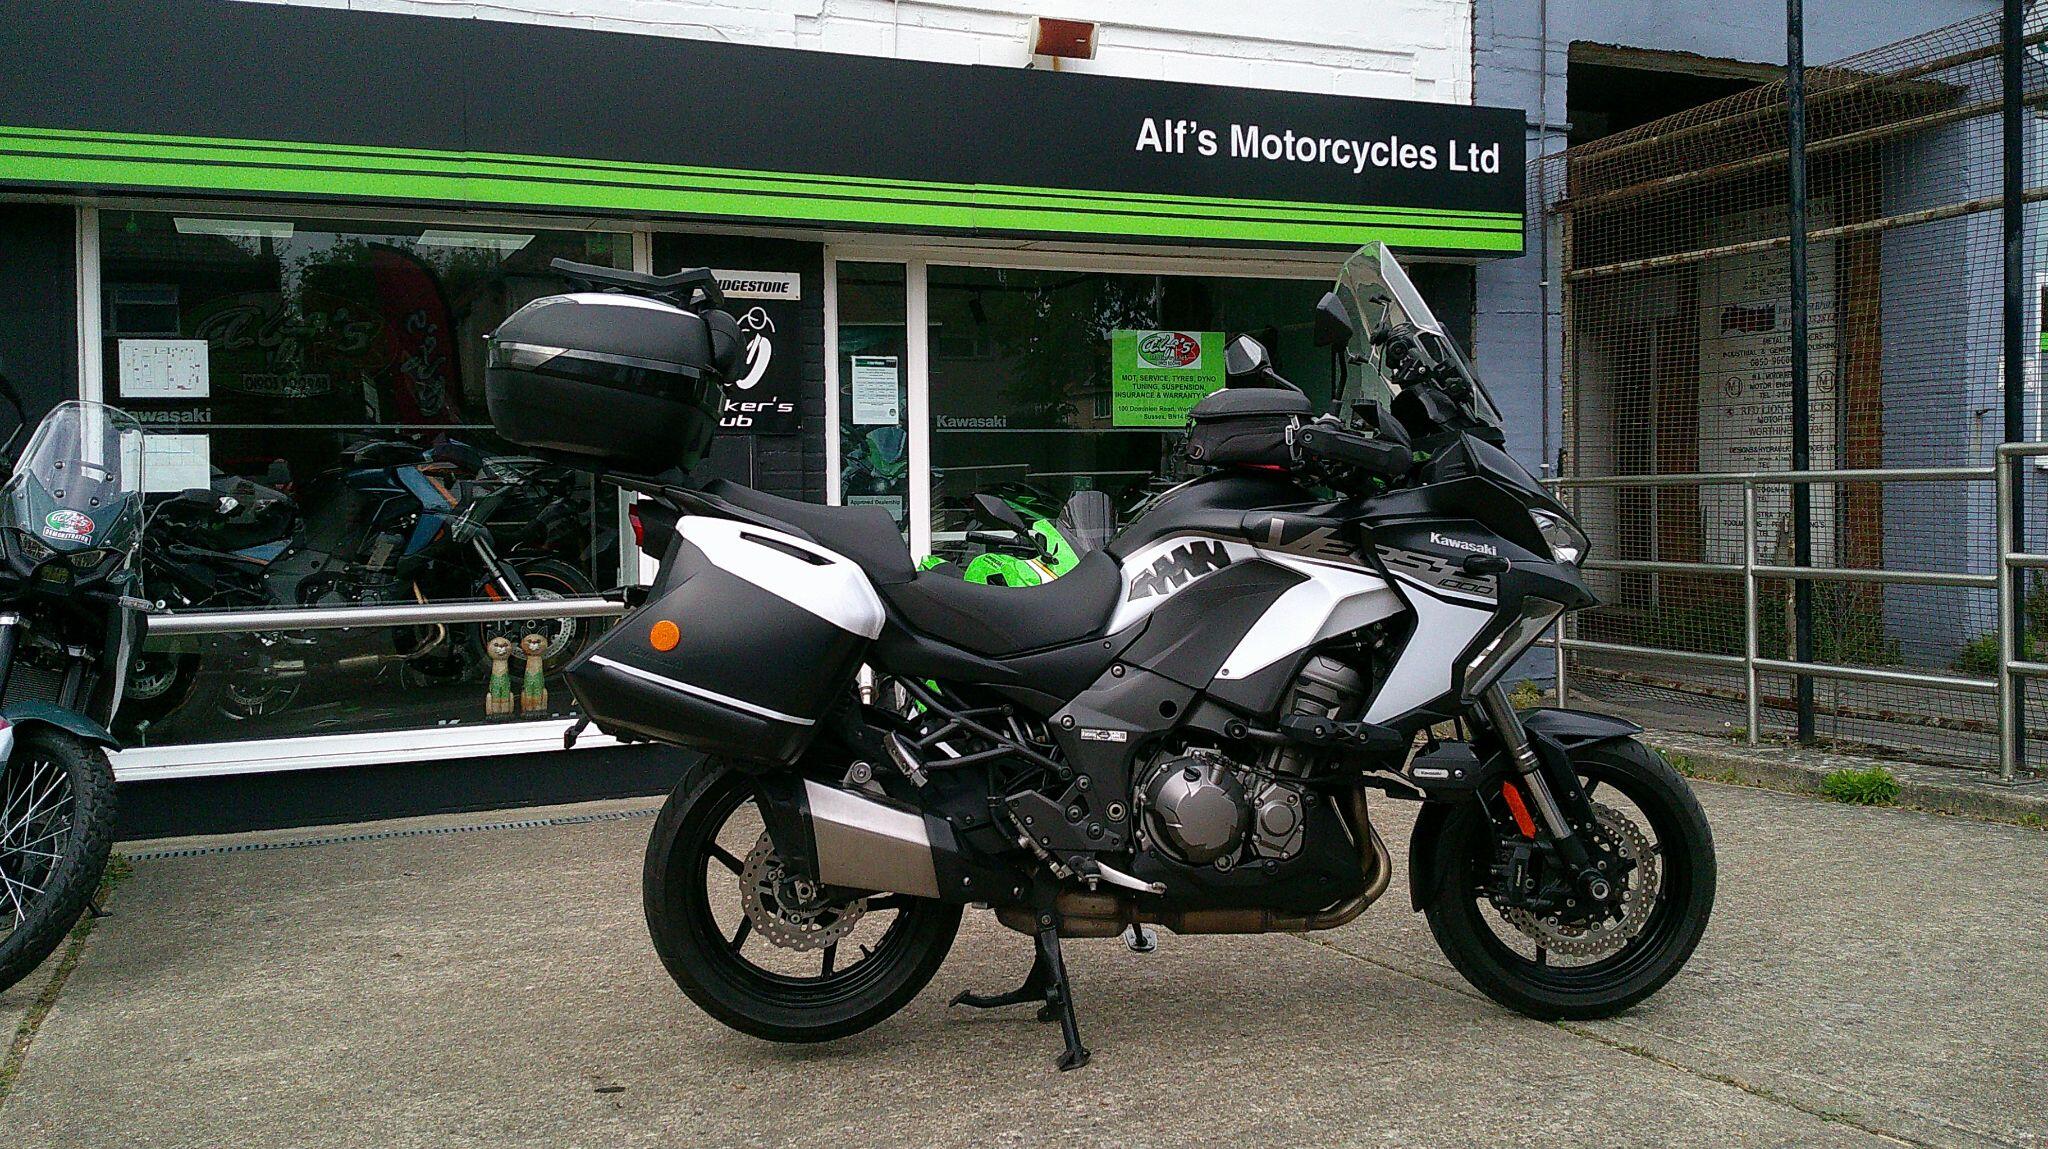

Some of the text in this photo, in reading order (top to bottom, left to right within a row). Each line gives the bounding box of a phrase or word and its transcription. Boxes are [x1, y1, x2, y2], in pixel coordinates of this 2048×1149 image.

[1135, 117, 1500, 175] Alf's Motorcycles Ltd
[717, 279, 790, 294] IDGESTONE
[1115, 391, 1155, 399] INSURANCE
[1156, 391, 1162, 399] &
[1163, 391, 1201, 399] WARRANTY
[723, 396, 795, 413] ker's
[719, 414, 754, 428] ub
[936, 414, 1008, 428] Kawasaki
[850, 498, 901, 507] Approved Dealership
[1429, 531, 1498, 557] Kawasaki
[1437, 579, 1494, 595] 1000
